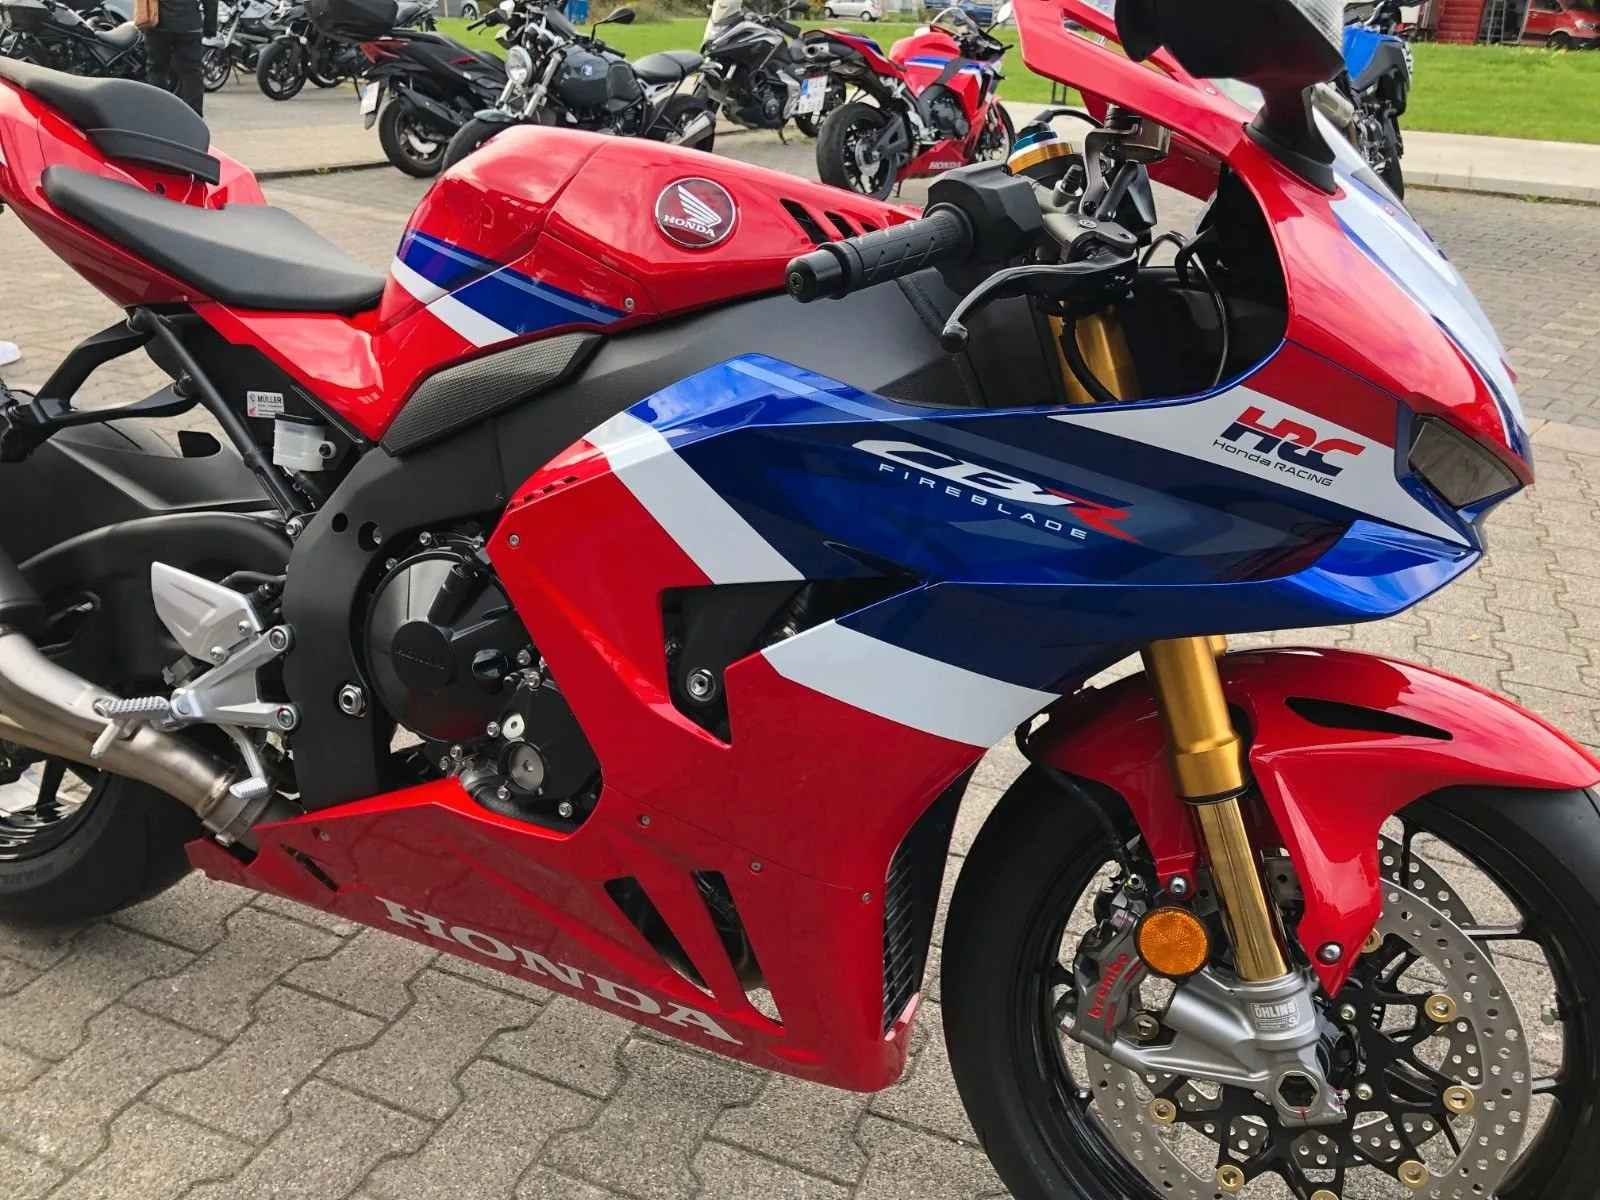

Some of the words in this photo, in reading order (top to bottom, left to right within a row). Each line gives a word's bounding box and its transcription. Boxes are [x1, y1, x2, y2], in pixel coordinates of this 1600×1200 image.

[663, 214, 716, 237] HONDA
[1212, 439, 1272, 467] Honda
[1273, 462, 1334, 487] RACING
[1220, 406, 1367, 477] HRC
[878, 463, 1088, 540] FIREBLADE
[374, 896, 743, 1046] HONDA
[1087, 953, 1130, 1019] brembo
